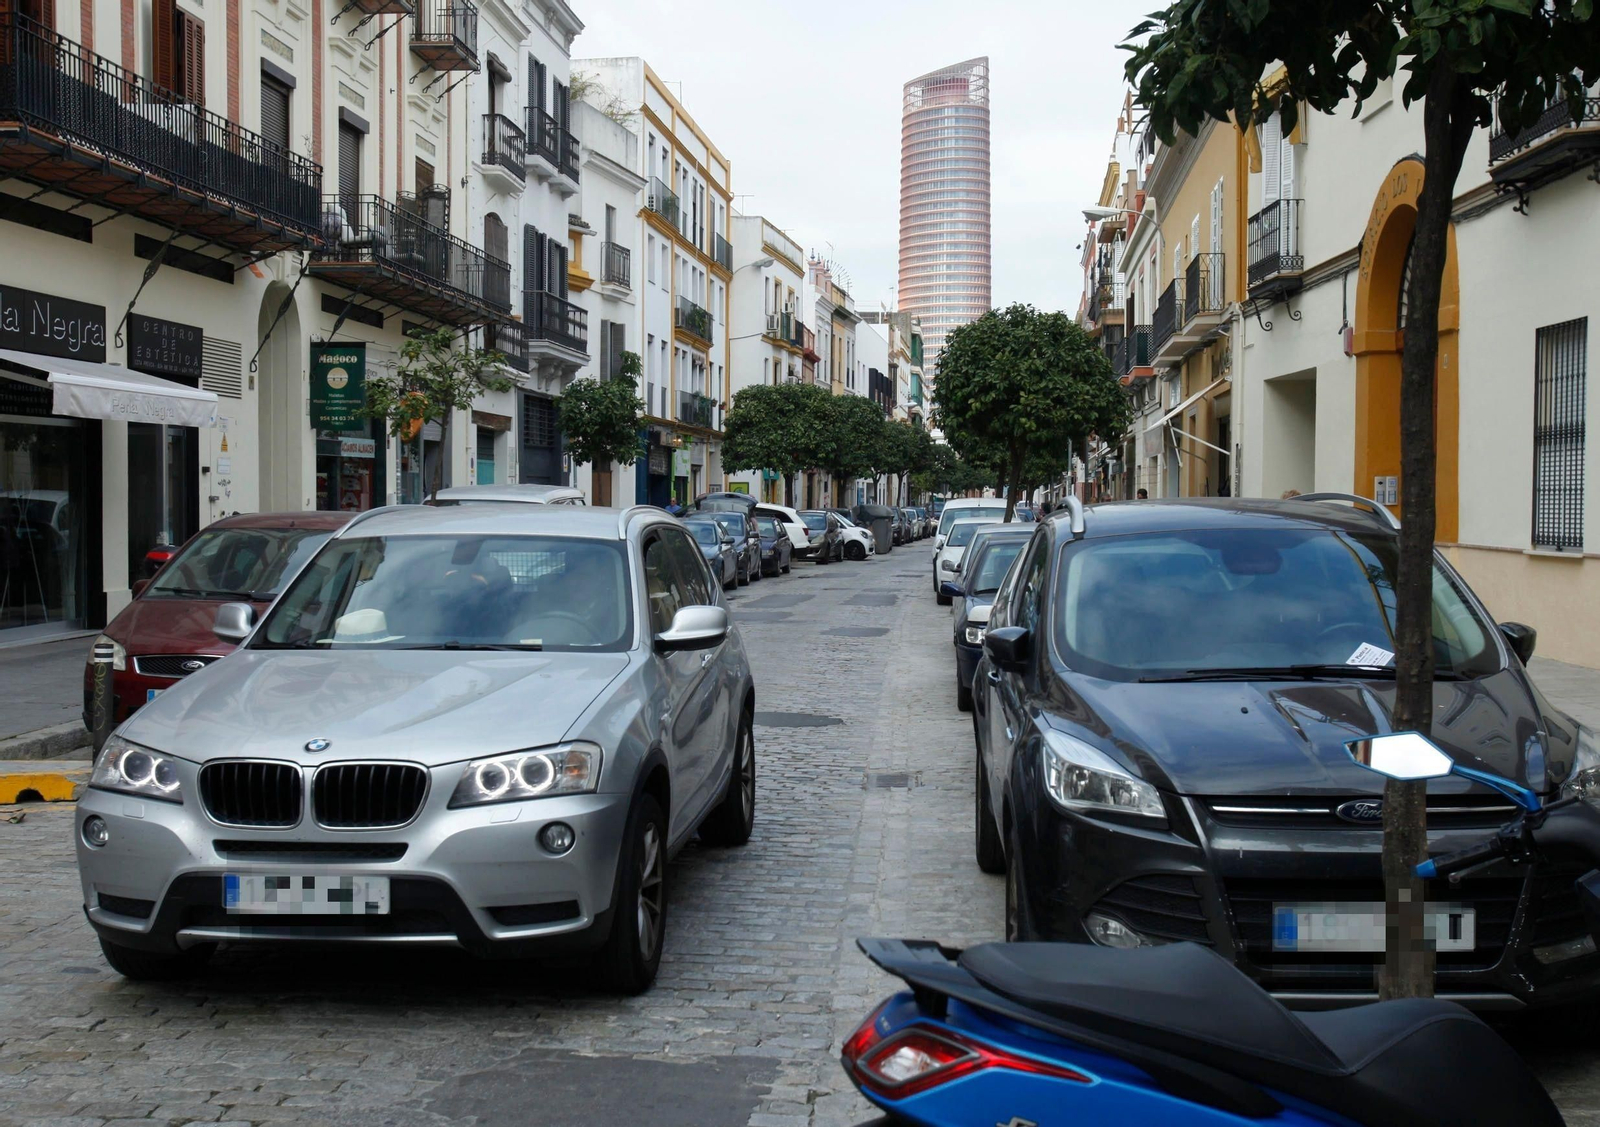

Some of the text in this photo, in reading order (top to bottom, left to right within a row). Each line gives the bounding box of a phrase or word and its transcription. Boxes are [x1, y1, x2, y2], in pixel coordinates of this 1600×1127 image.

[30, 299, 105, 352] Negra
[143, 321, 194, 341] CENTRO
[162, 338, 176, 350] DE
[318, 354, 357, 364] Magoco
[145, 399, 175, 421] Negra
